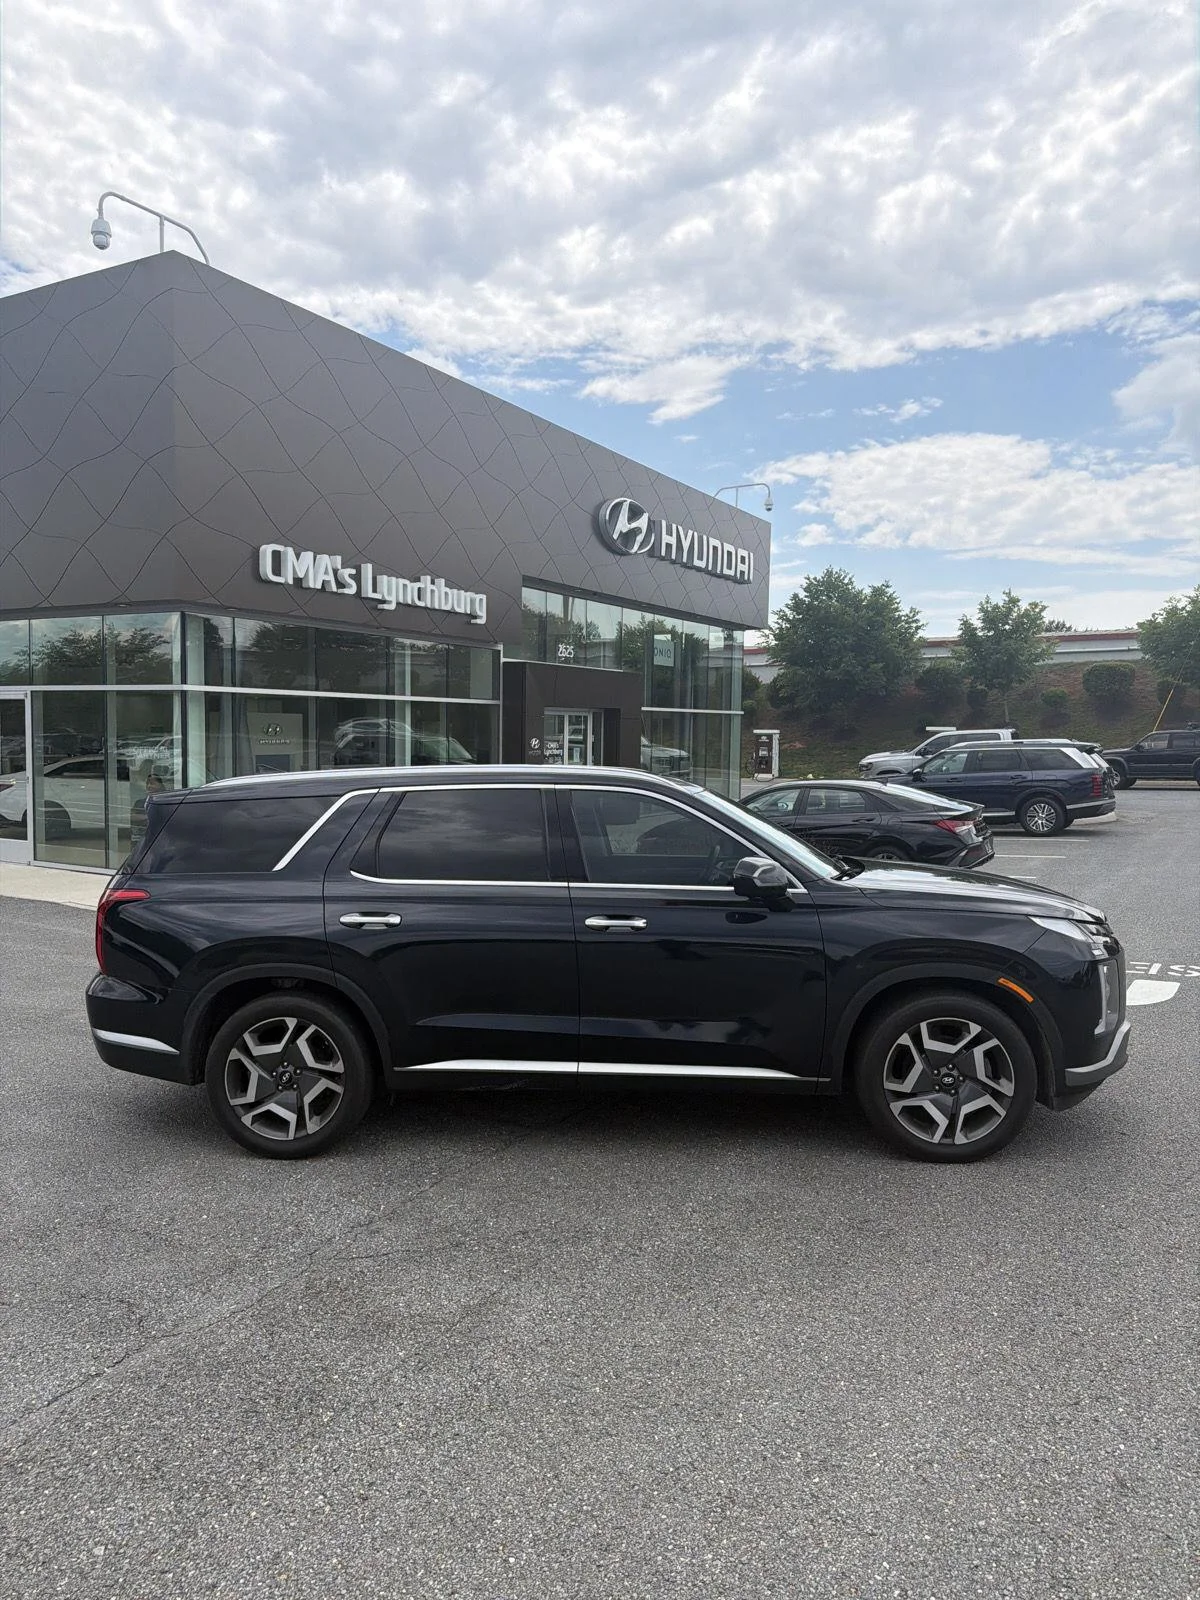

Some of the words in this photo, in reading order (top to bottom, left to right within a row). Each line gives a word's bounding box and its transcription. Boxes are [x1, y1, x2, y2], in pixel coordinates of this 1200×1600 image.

[660, 520, 755, 583] HYUNDAI
[259, 543, 357, 595] CMA's
[361, 563, 488, 624] Lynchburg
[558, 644, 574, 658] 2625
[653, 647, 672, 659] ONIQ
